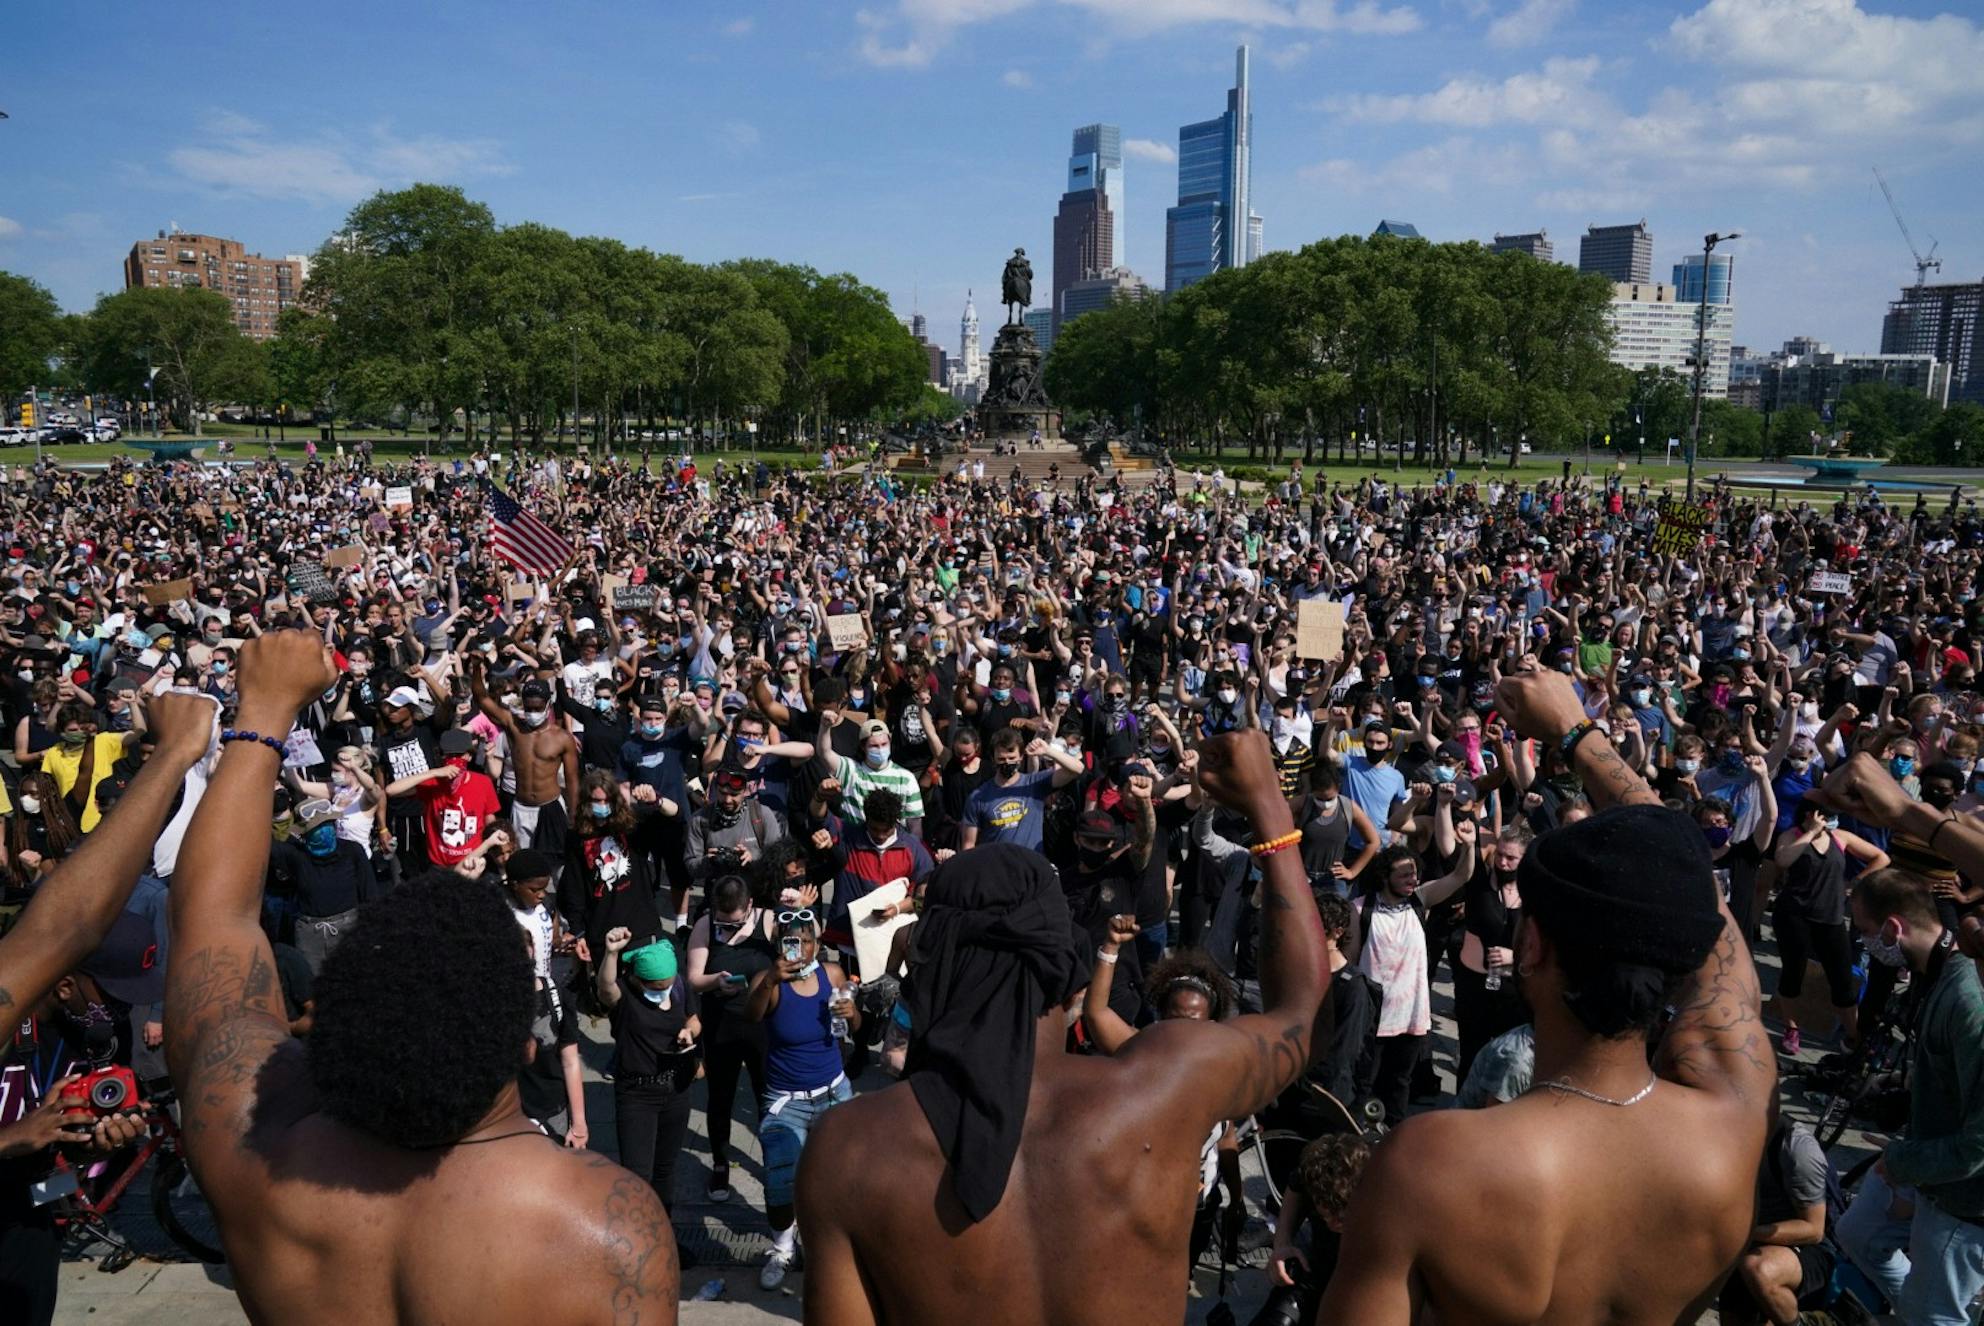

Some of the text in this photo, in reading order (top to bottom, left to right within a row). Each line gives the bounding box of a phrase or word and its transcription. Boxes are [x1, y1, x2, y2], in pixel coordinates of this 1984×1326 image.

[1661, 501, 1706, 525] BLACK
[1655, 523, 1699, 548] LIVES
[615, 585, 655, 597] BLACK
